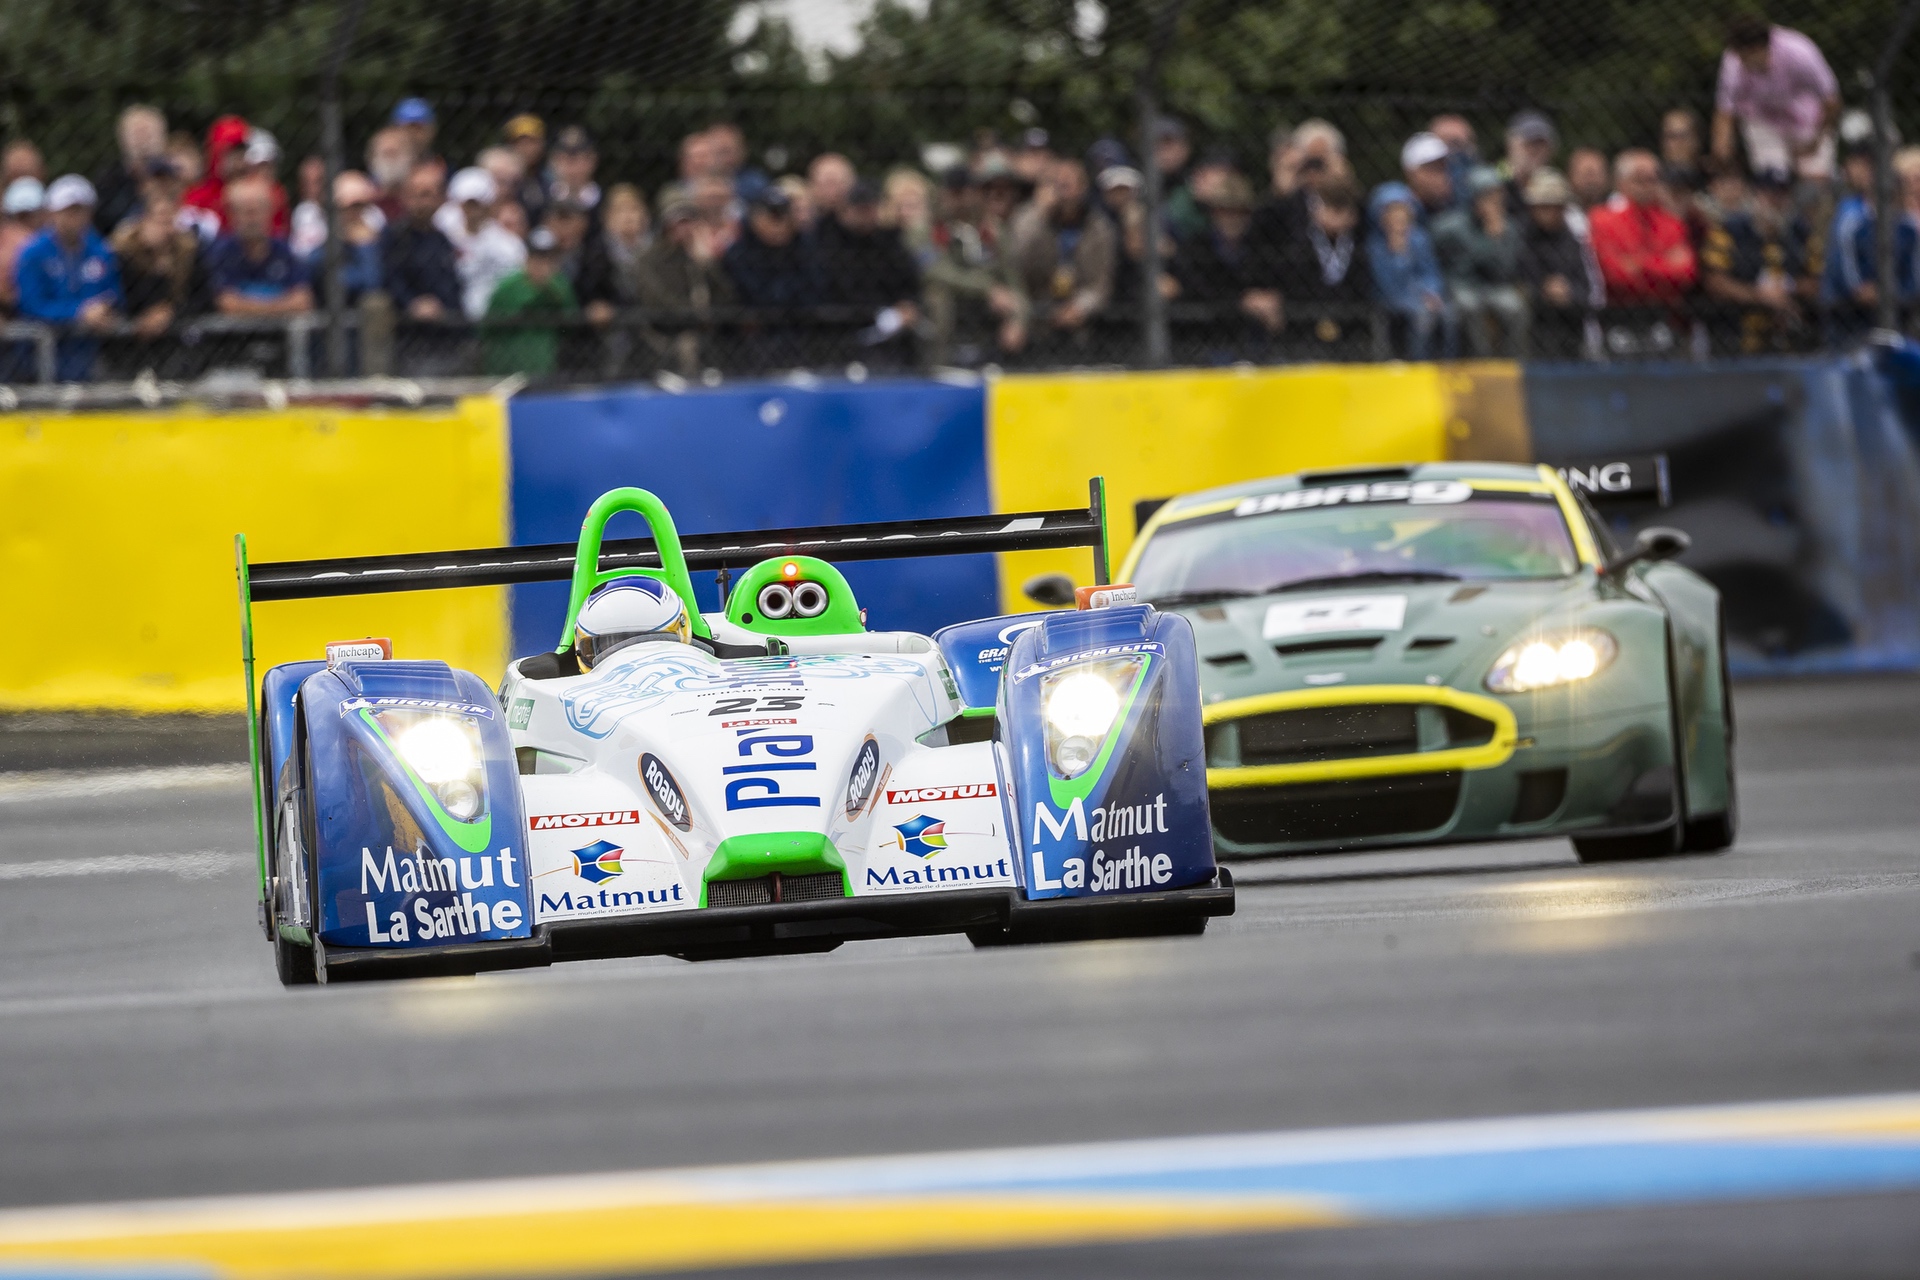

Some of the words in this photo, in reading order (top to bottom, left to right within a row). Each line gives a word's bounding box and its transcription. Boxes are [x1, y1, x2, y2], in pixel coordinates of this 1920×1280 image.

[337, 646, 381, 658] Inchcape
[1051, 643, 1158, 666] MICHELIN
[376, 698, 488, 713] MICHELIN
[708, 696, 806, 717] 23
[892, 784, 994, 803] MOTUL
[534, 811, 637, 829] MOTUL
[1032, 792, 1169, 845] Matmut
[361, 845, 520, 895] Matmut
[866, 858, 1010, 886] Matmut
[1031, 851, 1085, 891] La
[1090, 845, 1173, 892] Sarthe
[540, 883, 684, 913] Matmut
[365, 901, 410, 943] La
[414, 892, 523, 940] Sarthe
